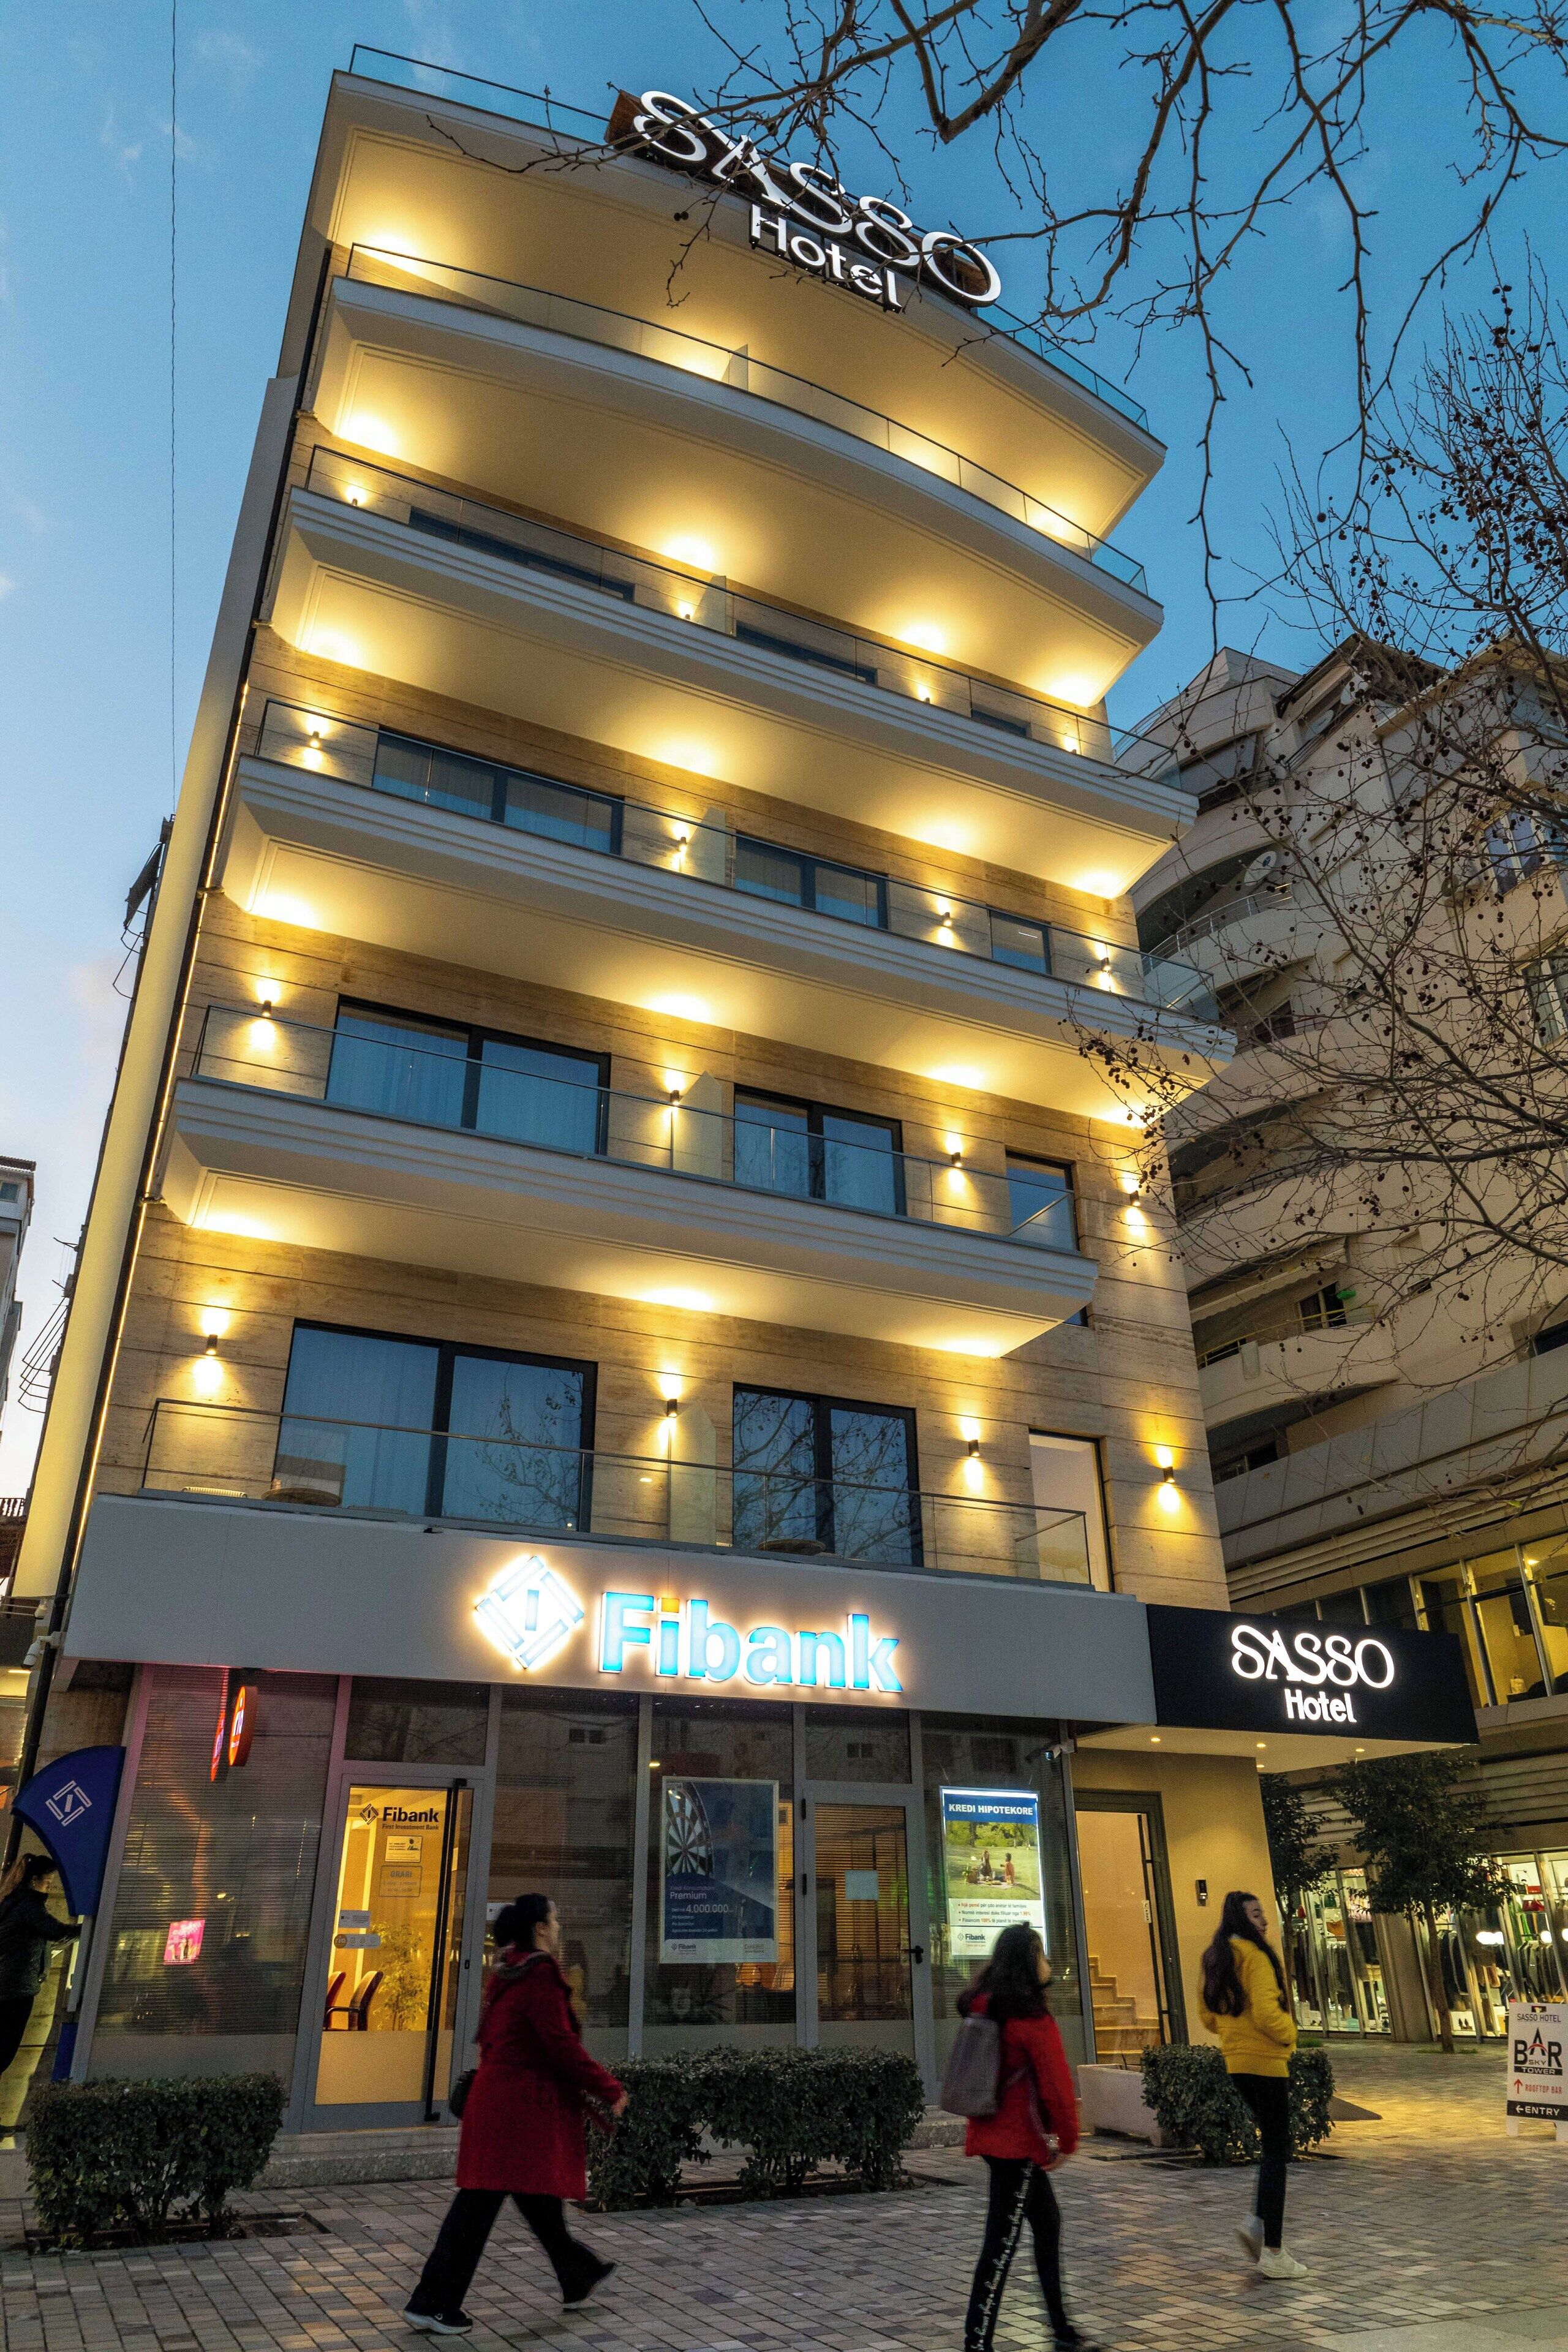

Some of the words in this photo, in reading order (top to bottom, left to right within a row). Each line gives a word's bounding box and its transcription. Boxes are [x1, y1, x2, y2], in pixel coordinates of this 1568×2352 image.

[633, 90, 1001, 307] SASSO
[750, 203, 903, 312] Hotel
[598, 1590, 903, 1693] Fibank
[1231, 1624, 1396, 1689] SASSO
[1284, 1688, 1357, 1723] Hotel
[382, 1806, 439, 1822] Fibank
[949, 1804, 976, 1813] KREDI
[978, 1804, 1033, 1815] HIPOTEKORE
[670, 1891, 707, 1899] Premium
[685, 1904, 729, 1913] 4.000.000
[1517, 2013, 1538, 2021] SASSO
[1540, 2014, 1561, 2022] HOTEL
[1514, 2027, 1562, 2068] BAR
[1521, 2066, 1556, 2075] TOWER
[1525, 2084, 1549, 2094] ROOFTOP
[1551, 2086, 1562, 2094] BAR
[1525, 2106, 1560, 2116] ENTRY
